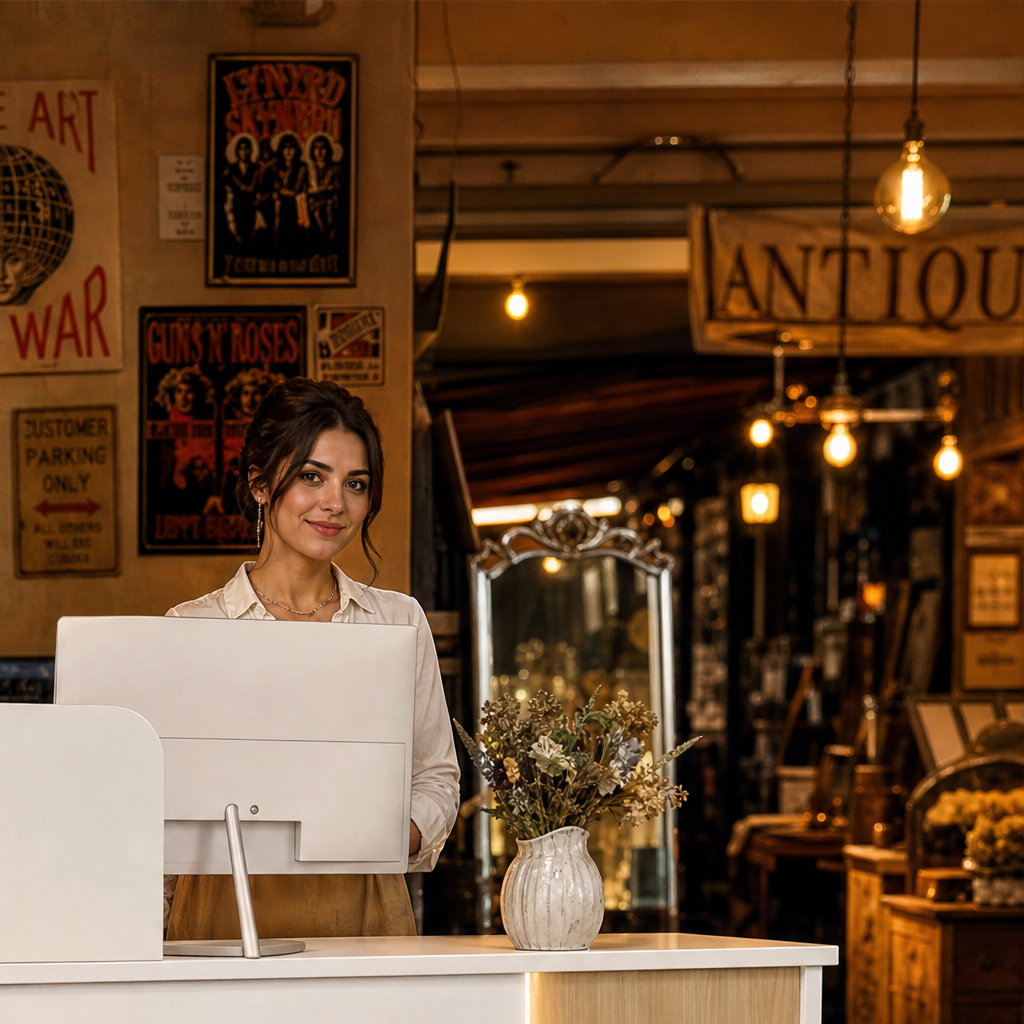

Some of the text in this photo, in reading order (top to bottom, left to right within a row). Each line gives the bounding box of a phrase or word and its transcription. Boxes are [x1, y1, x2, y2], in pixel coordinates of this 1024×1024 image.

[28, 89, 99, 175] ART
[9, 264, 111, 361] WAR
[720, 245, 1024, 332] ANTIQU
[148, 320, 204, 365] GUNS
[230, 319, 299, 365] ROSES
[26, 446, 107, 466] PARKING
[42, 473, 91, 493] ONLY
